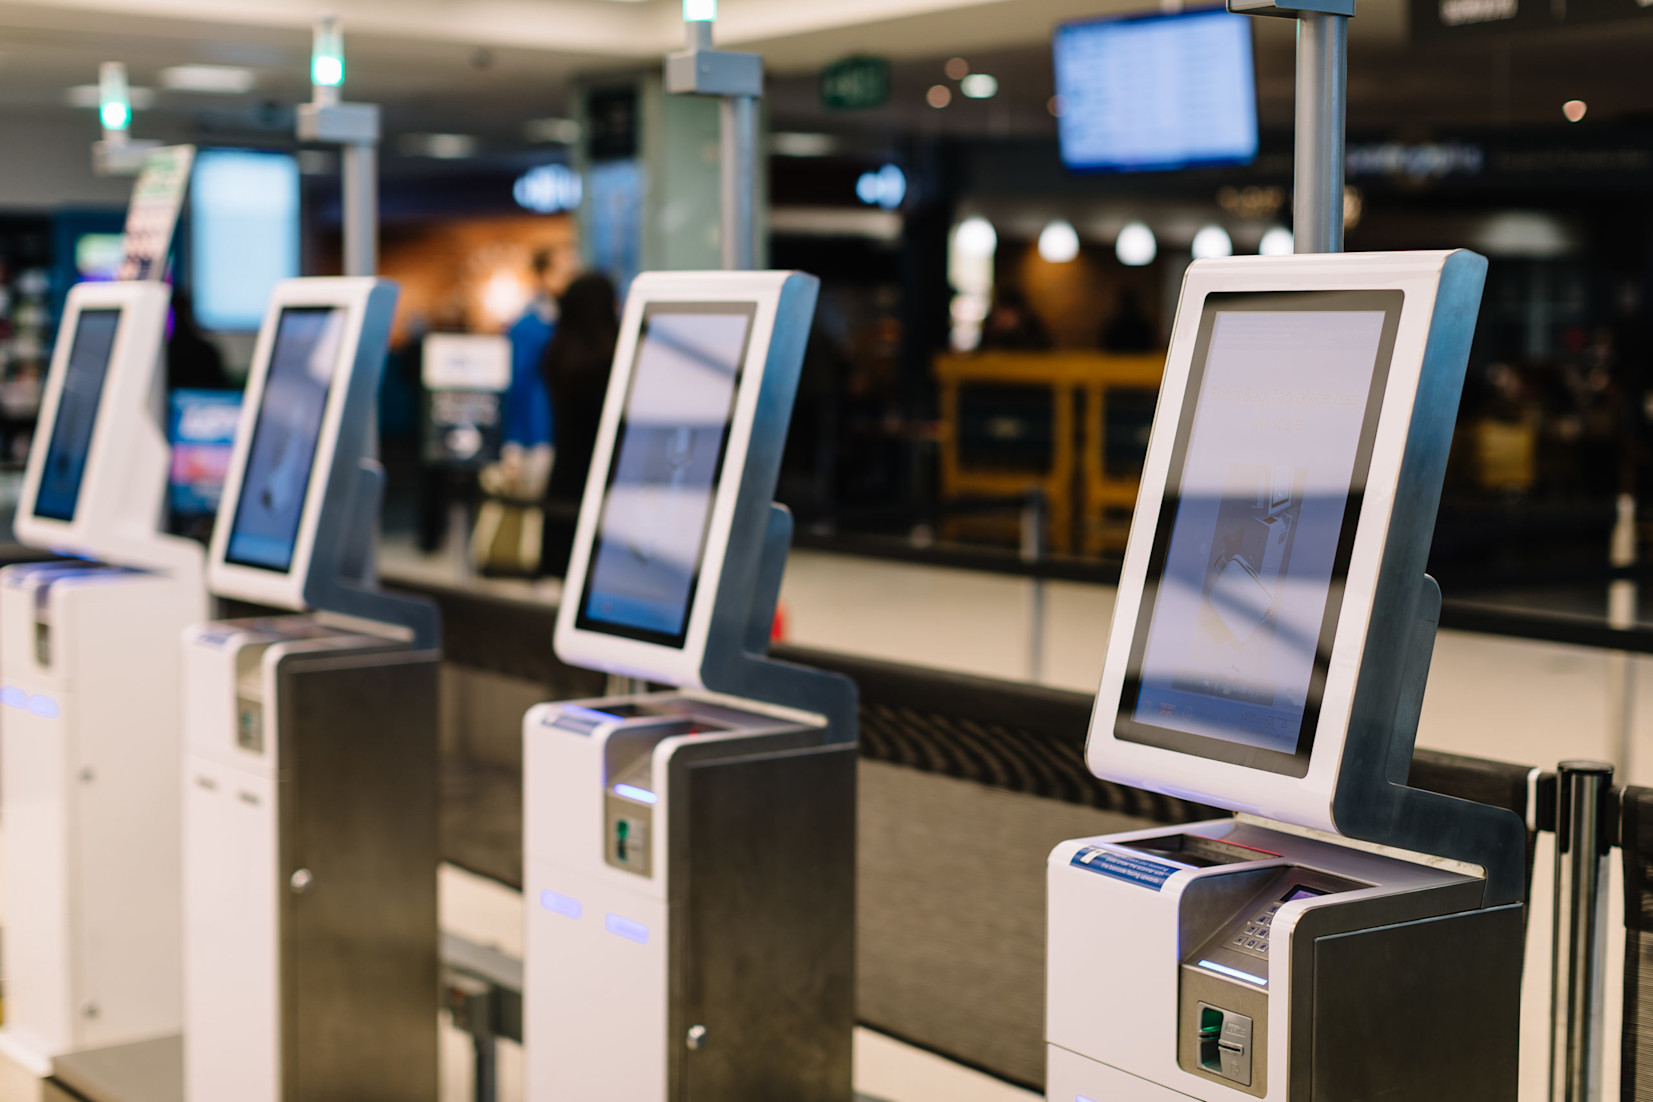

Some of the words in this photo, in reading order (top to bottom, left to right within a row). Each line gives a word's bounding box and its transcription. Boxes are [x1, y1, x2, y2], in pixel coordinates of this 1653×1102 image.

[1243, 387, 1267, 407] Bag
[1272, 387, 1293, 407] Tag
[1295, 389, 1330, 408] place
[1271, 416, 1304, 433] scale
